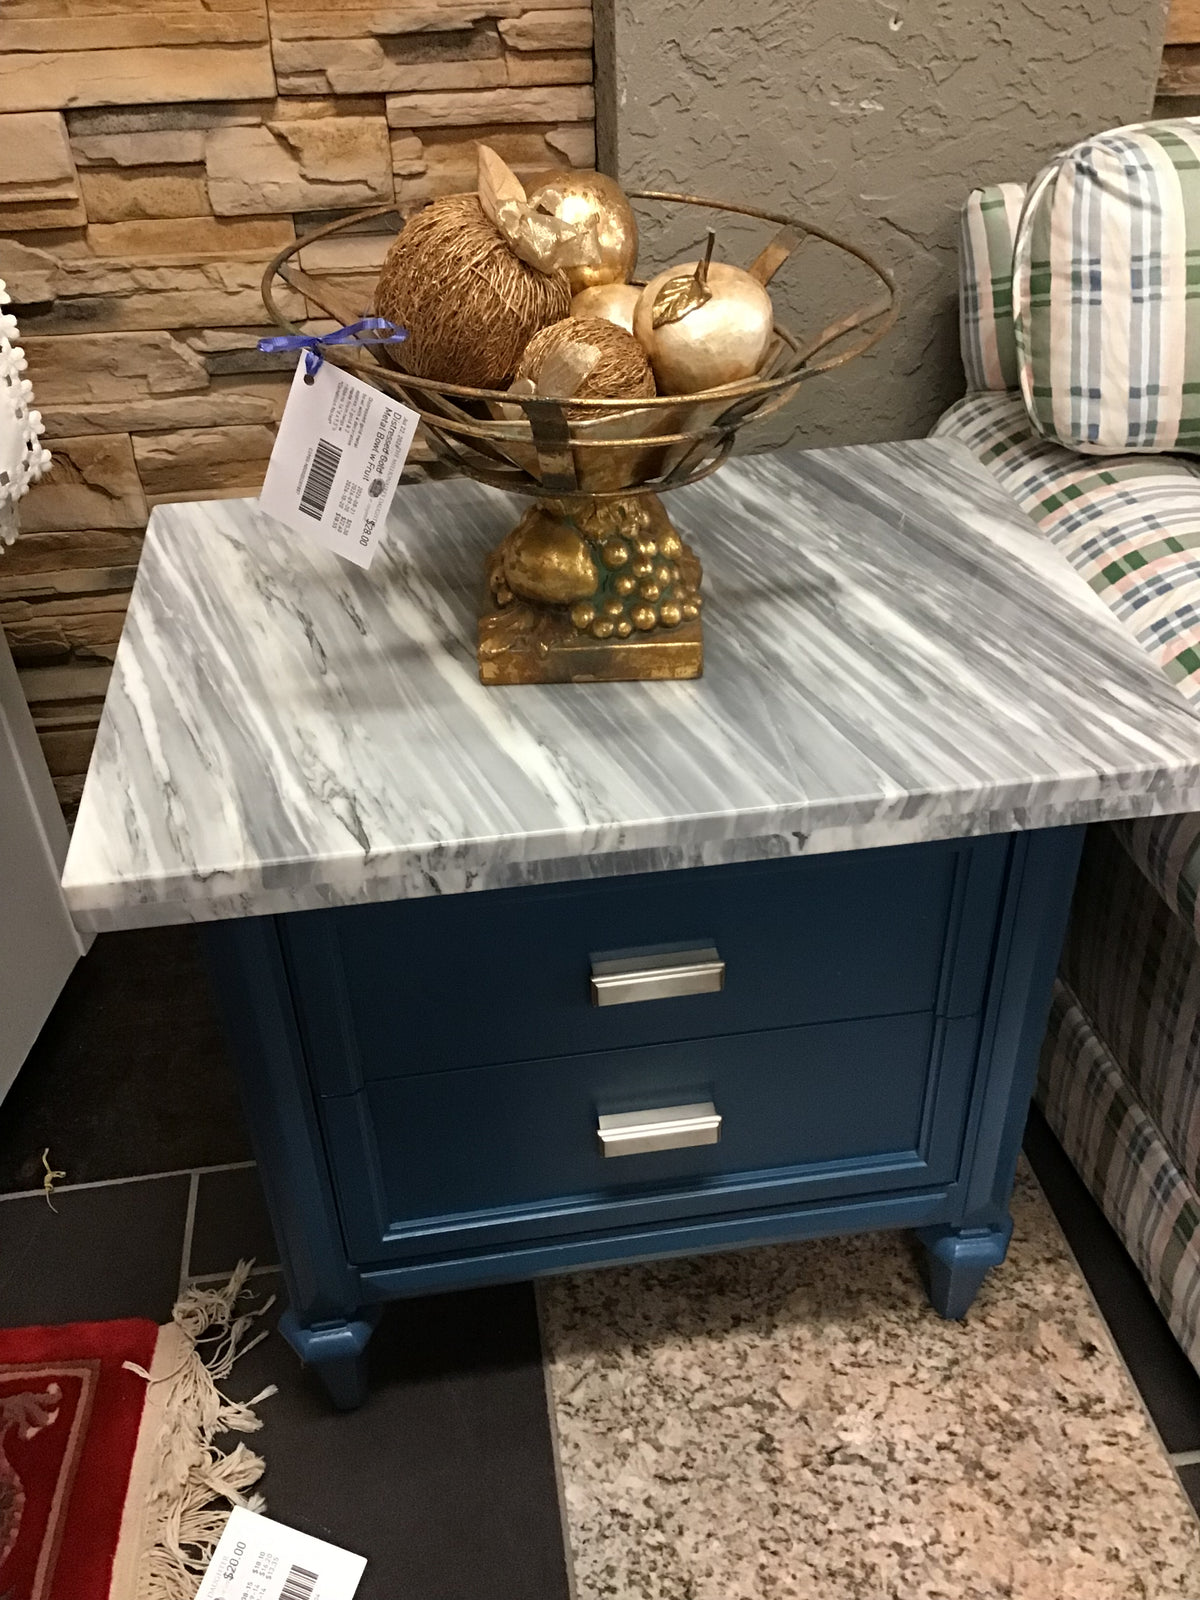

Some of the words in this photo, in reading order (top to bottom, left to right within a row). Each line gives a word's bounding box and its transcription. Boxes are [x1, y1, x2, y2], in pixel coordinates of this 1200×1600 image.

[361, 396, 373, 423] Distressed
[378, 406, 392, 432] Metal
[371, 430, 384, 453] Bowl
[381, 411, 402, 455] Distressed
[368, 452, 376, 461] w
[375, 453, 388, 474] Gold
[362, 461, 375, 482] Fruit
[358, 517, 375, 547] $28.00
[221, 1540, 248, 1581] $20.00
[251, 1550, 267, 1574] $18.10
[258, 1552, 273, 1577] $16.20
